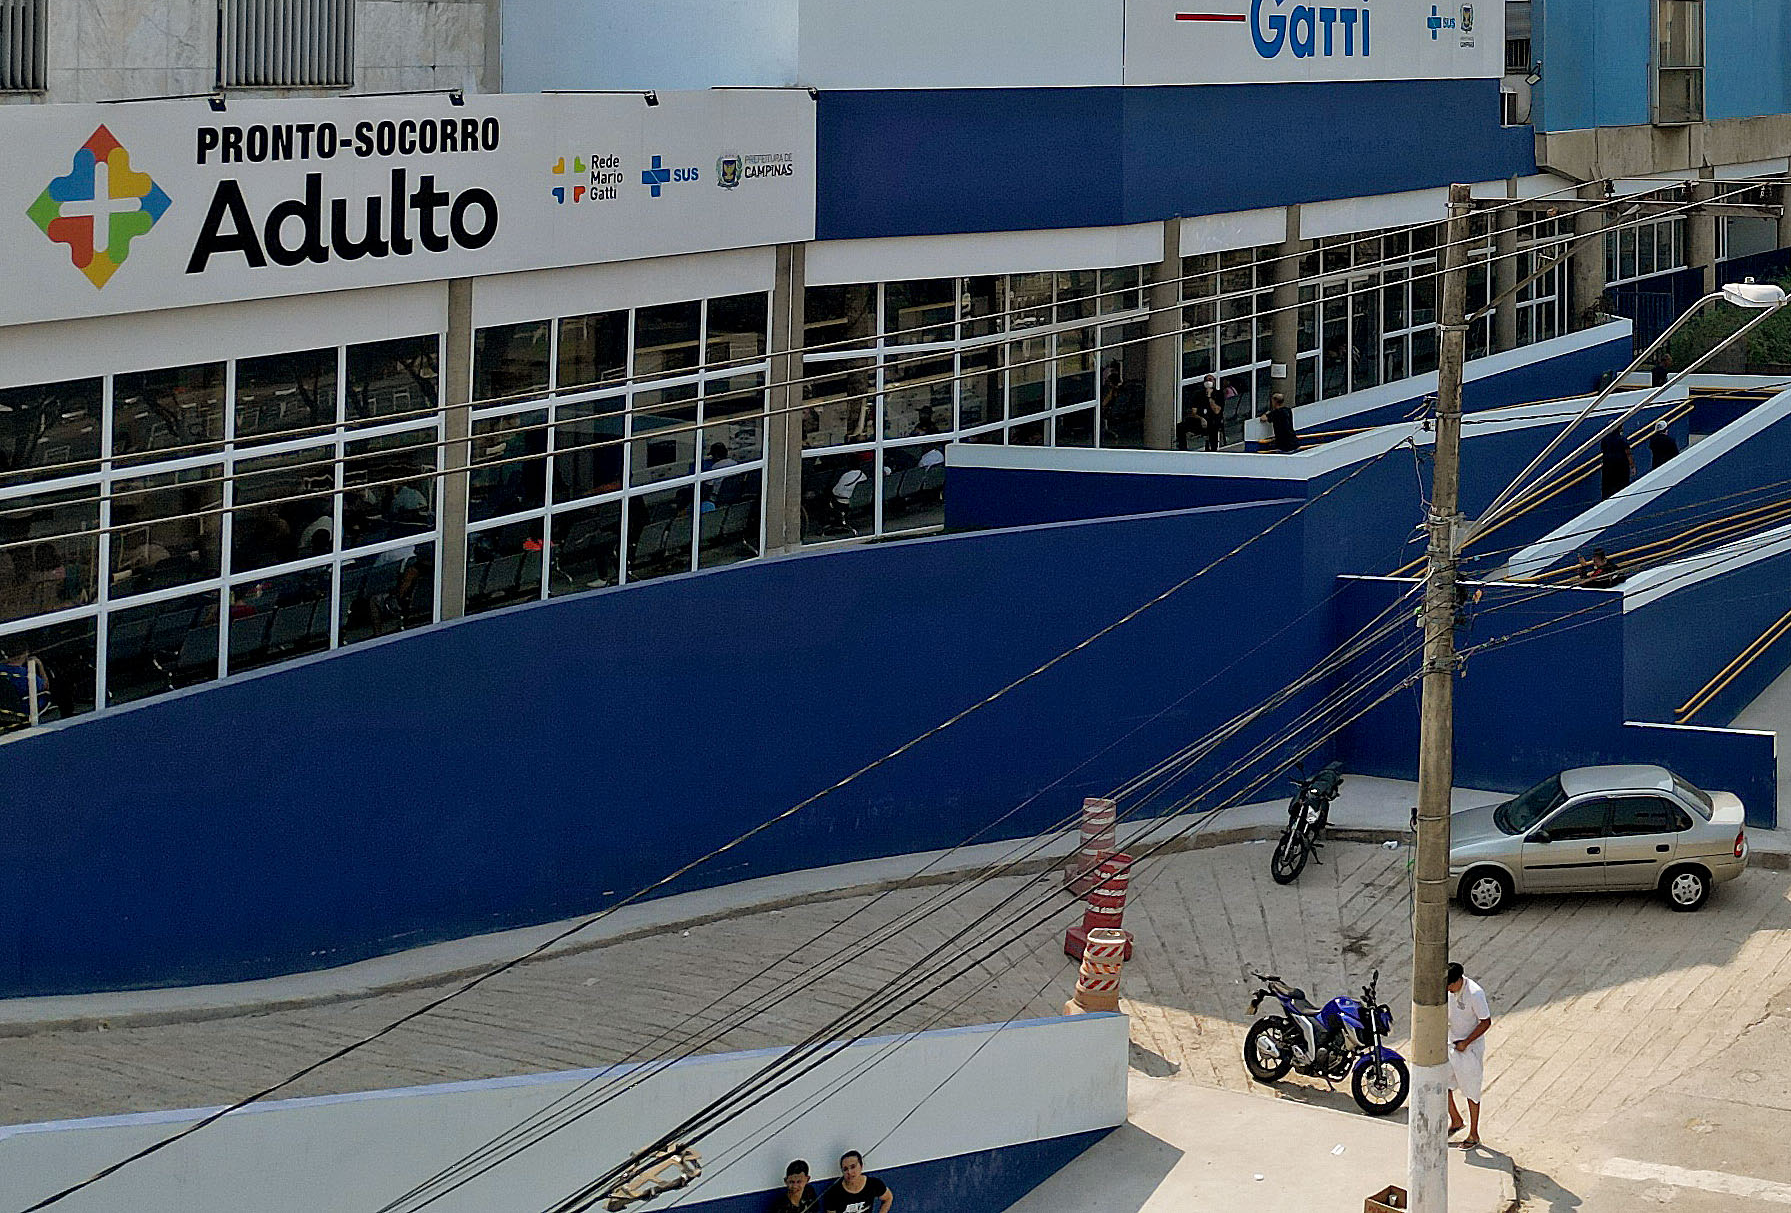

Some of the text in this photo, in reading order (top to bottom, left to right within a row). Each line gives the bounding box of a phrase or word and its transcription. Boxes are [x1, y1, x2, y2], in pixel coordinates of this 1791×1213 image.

[197, 117, 500, 166] PRONTO-SOCORRO
[591, 153, 620, 169] Rede
[673, 167, 699, 183] SUS
[744, 163, 793, 179] CAMPINAS
[590, 185, 617, 201] Gatti
[185, 167, 499, 275] Adulto
